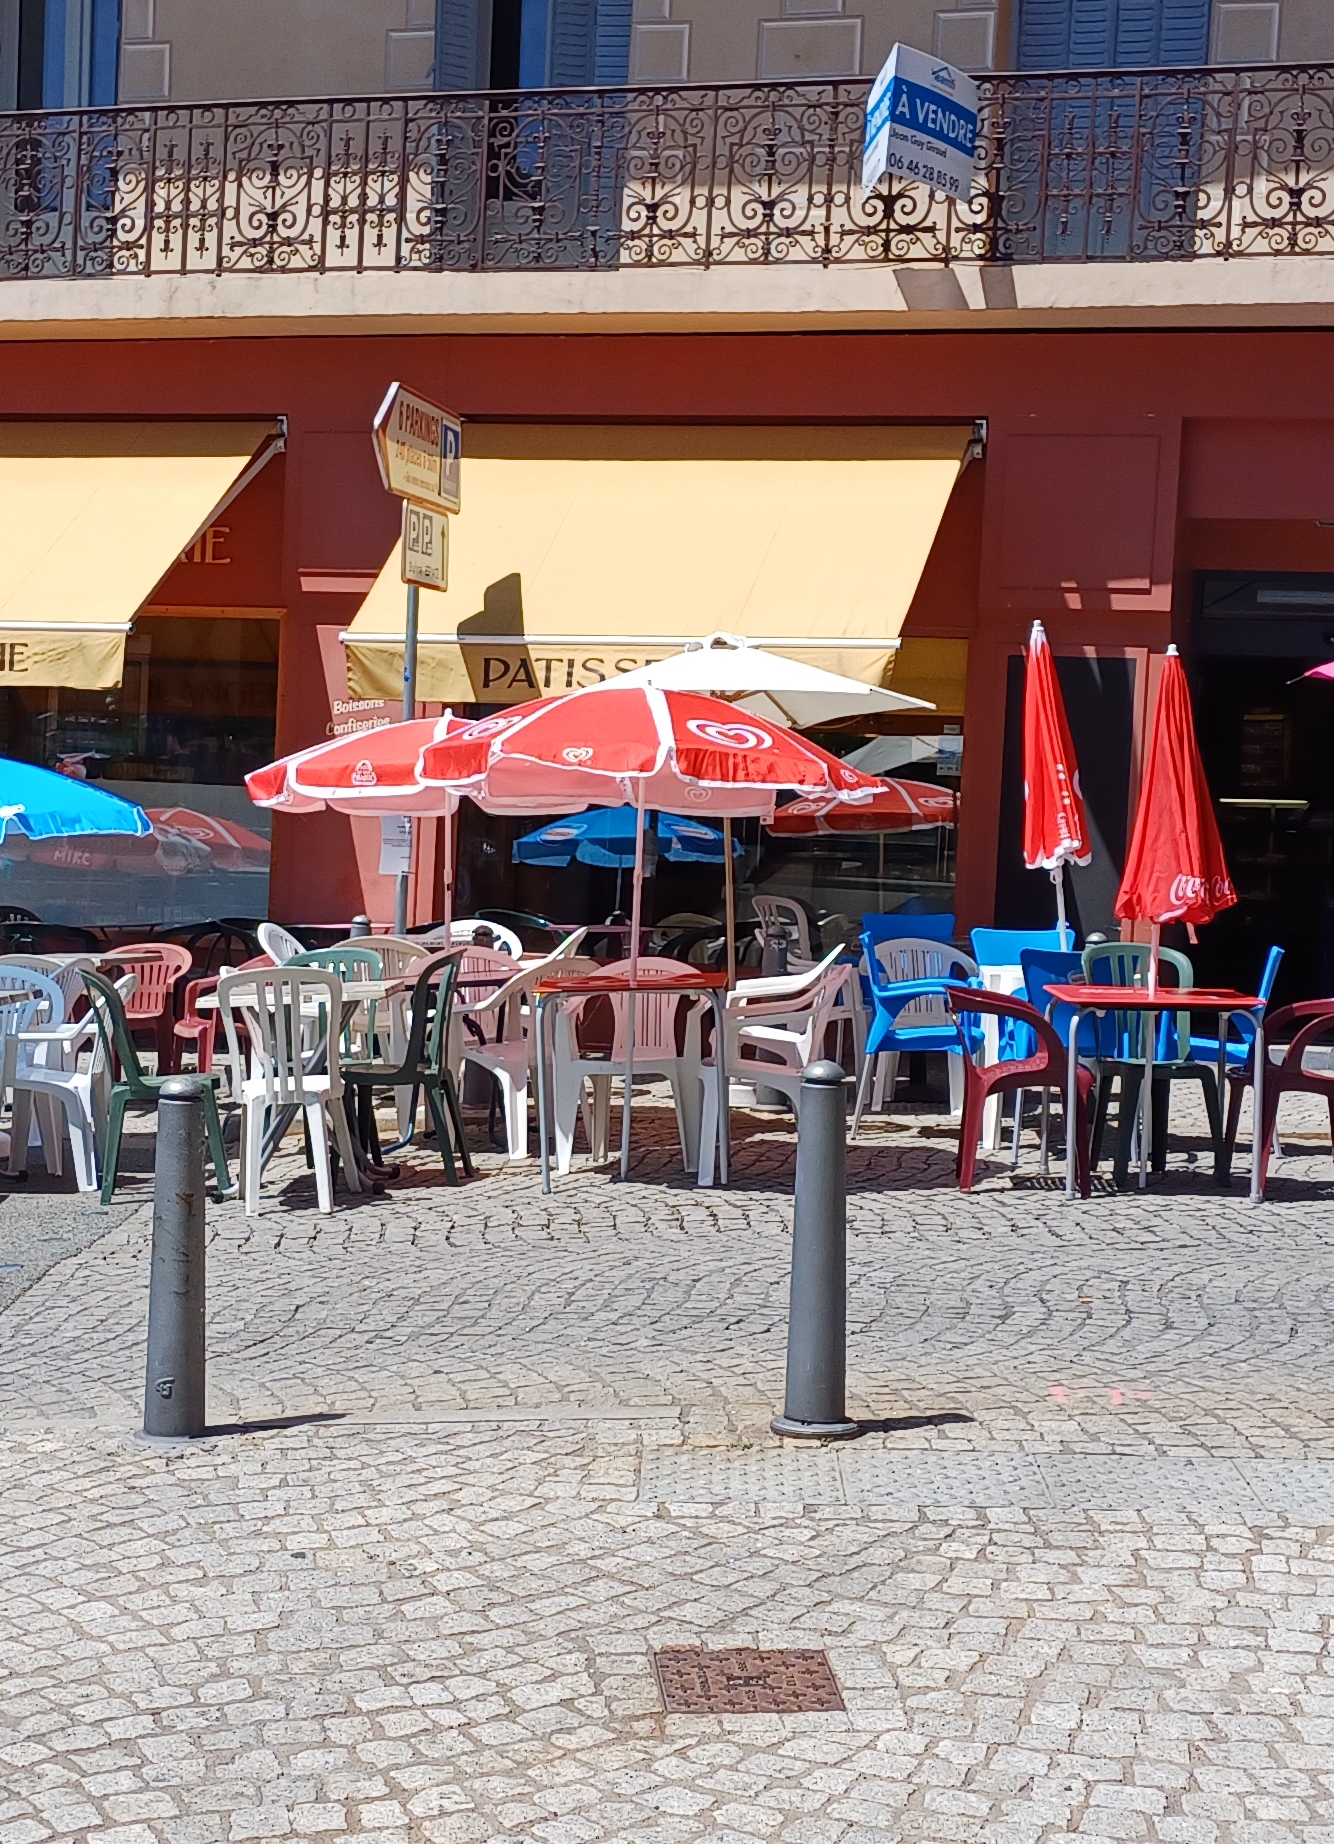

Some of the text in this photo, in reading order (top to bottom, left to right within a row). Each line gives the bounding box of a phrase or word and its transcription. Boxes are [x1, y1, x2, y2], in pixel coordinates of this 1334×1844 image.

[896, 85, 910, 119] À
[916, 99, 974, 148] VENDRE
[889, 152, 904, 170] 06
[906, 159, 920, 175] 46
[922, 164, 935, 183] 28
[948, 176, 960, 192] 99
[482, 657, 664, 689] PATISS
[333, 699, 385, 715] Boissons
